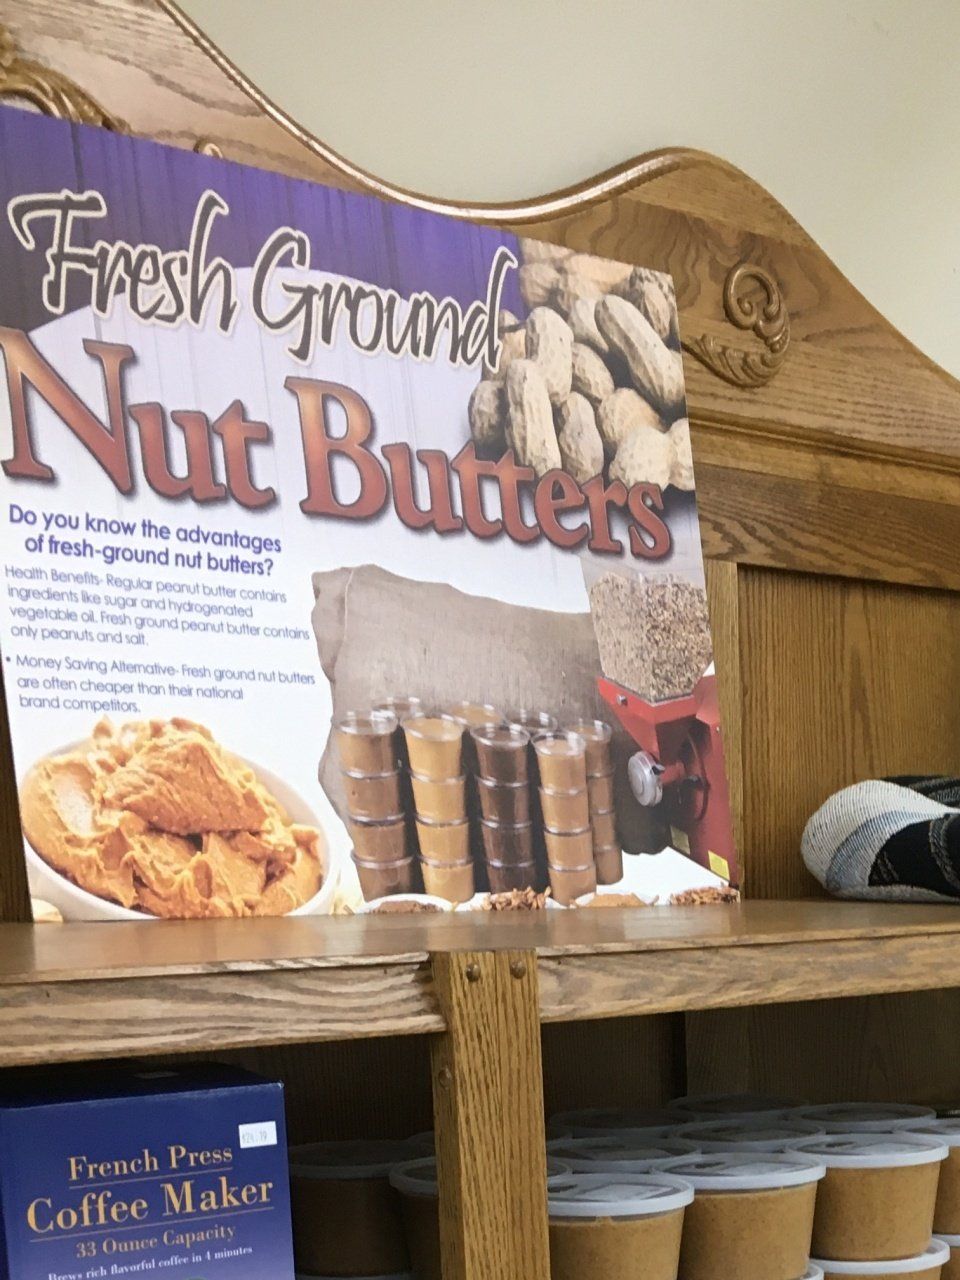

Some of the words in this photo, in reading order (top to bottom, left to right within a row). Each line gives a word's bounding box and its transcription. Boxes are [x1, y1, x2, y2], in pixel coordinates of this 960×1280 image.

[8, 190, 238, 336] Fresh
[252, 227, 518, 371] Ground
[0, 326, 277, 509] Nut
[284, 376, 672, 559] Butters
[9, 504, 37, 525] Do
[42, 511, 79, 531] you
[85, 512, 136, 536] know
[142, 519, 170, 540] the
[176, 525, 281, 554] advantages
[25, 534, 44, 552] of
[48, 535, 169, 565] fresh-ground
[175, 552, 201, 568] nut
[207, 553, 274, 576] butters?
[5, 565, 48, 581] Health
[106, 574, 153, 593] Regular
[156, 579, 200, 598] peanut
[202, 583, 237, 599] butter
[239, 588, 287, 603] contains
[7, 585, 79, 603] ingredients
[81, 591, 101, 605] like
[104, 595, 137, 611] sugar
[141, 597, 166, 611] and
[168, 599, 253, 618] hydrogenated
[9, 606, 78, 624] vegetable
[81, 609, 98, 624] oil.
[100, 611, 132, 626] Fresh
[135, 616, 179, 634] ground
[181, 619, 224, 636] peanut
[226, 621, 260, 636] butter
[263, 626, 310, 641] contains
[10, 625, 38, 642] only
[41, 628, 94, 644] peanuts
[97, 631, 122, 645] and
[125, 633, 149, 647] salt.
[16, 654, 62, 671] Money
[64, 656, 107, 675] Saving
[182, 664, 211, 679] Fresh
[214, 667, 256, 684] ground
[258, 670, 276, 683] nut
[279, 670, 315, 686] butters
[17, 676, 39, 690] are
[42, 676, 77, 691] often
[80, 679, 134, 697] cheaper
[137, 682, 166, 697] than
[168, 683, 193, 698] their
[196, 686, 244, 701] national
[19, 694, 60, 709] brand
[63, 697, 142, 714] competitors.
[68, 1148, 159, 1182] French
[167, 1145, 233, 1170] Press
[27, 1190, 149, 1234] Coffee
[161, 1176, 274, 1217] Maker
[76, 1241, 97, 1259] 33
[102, 1236, 158, 1256] Ounce
[163, 1225, 236, 1249] Capacity
[86, 1264, 107, 1279] rich
[110, 1259, 155, 1275] flavorful
[158, 1255, 189, 1269] coffee
[192, 1252, 202, 1263] in
[214, 1246, 253, 1261] minutes
